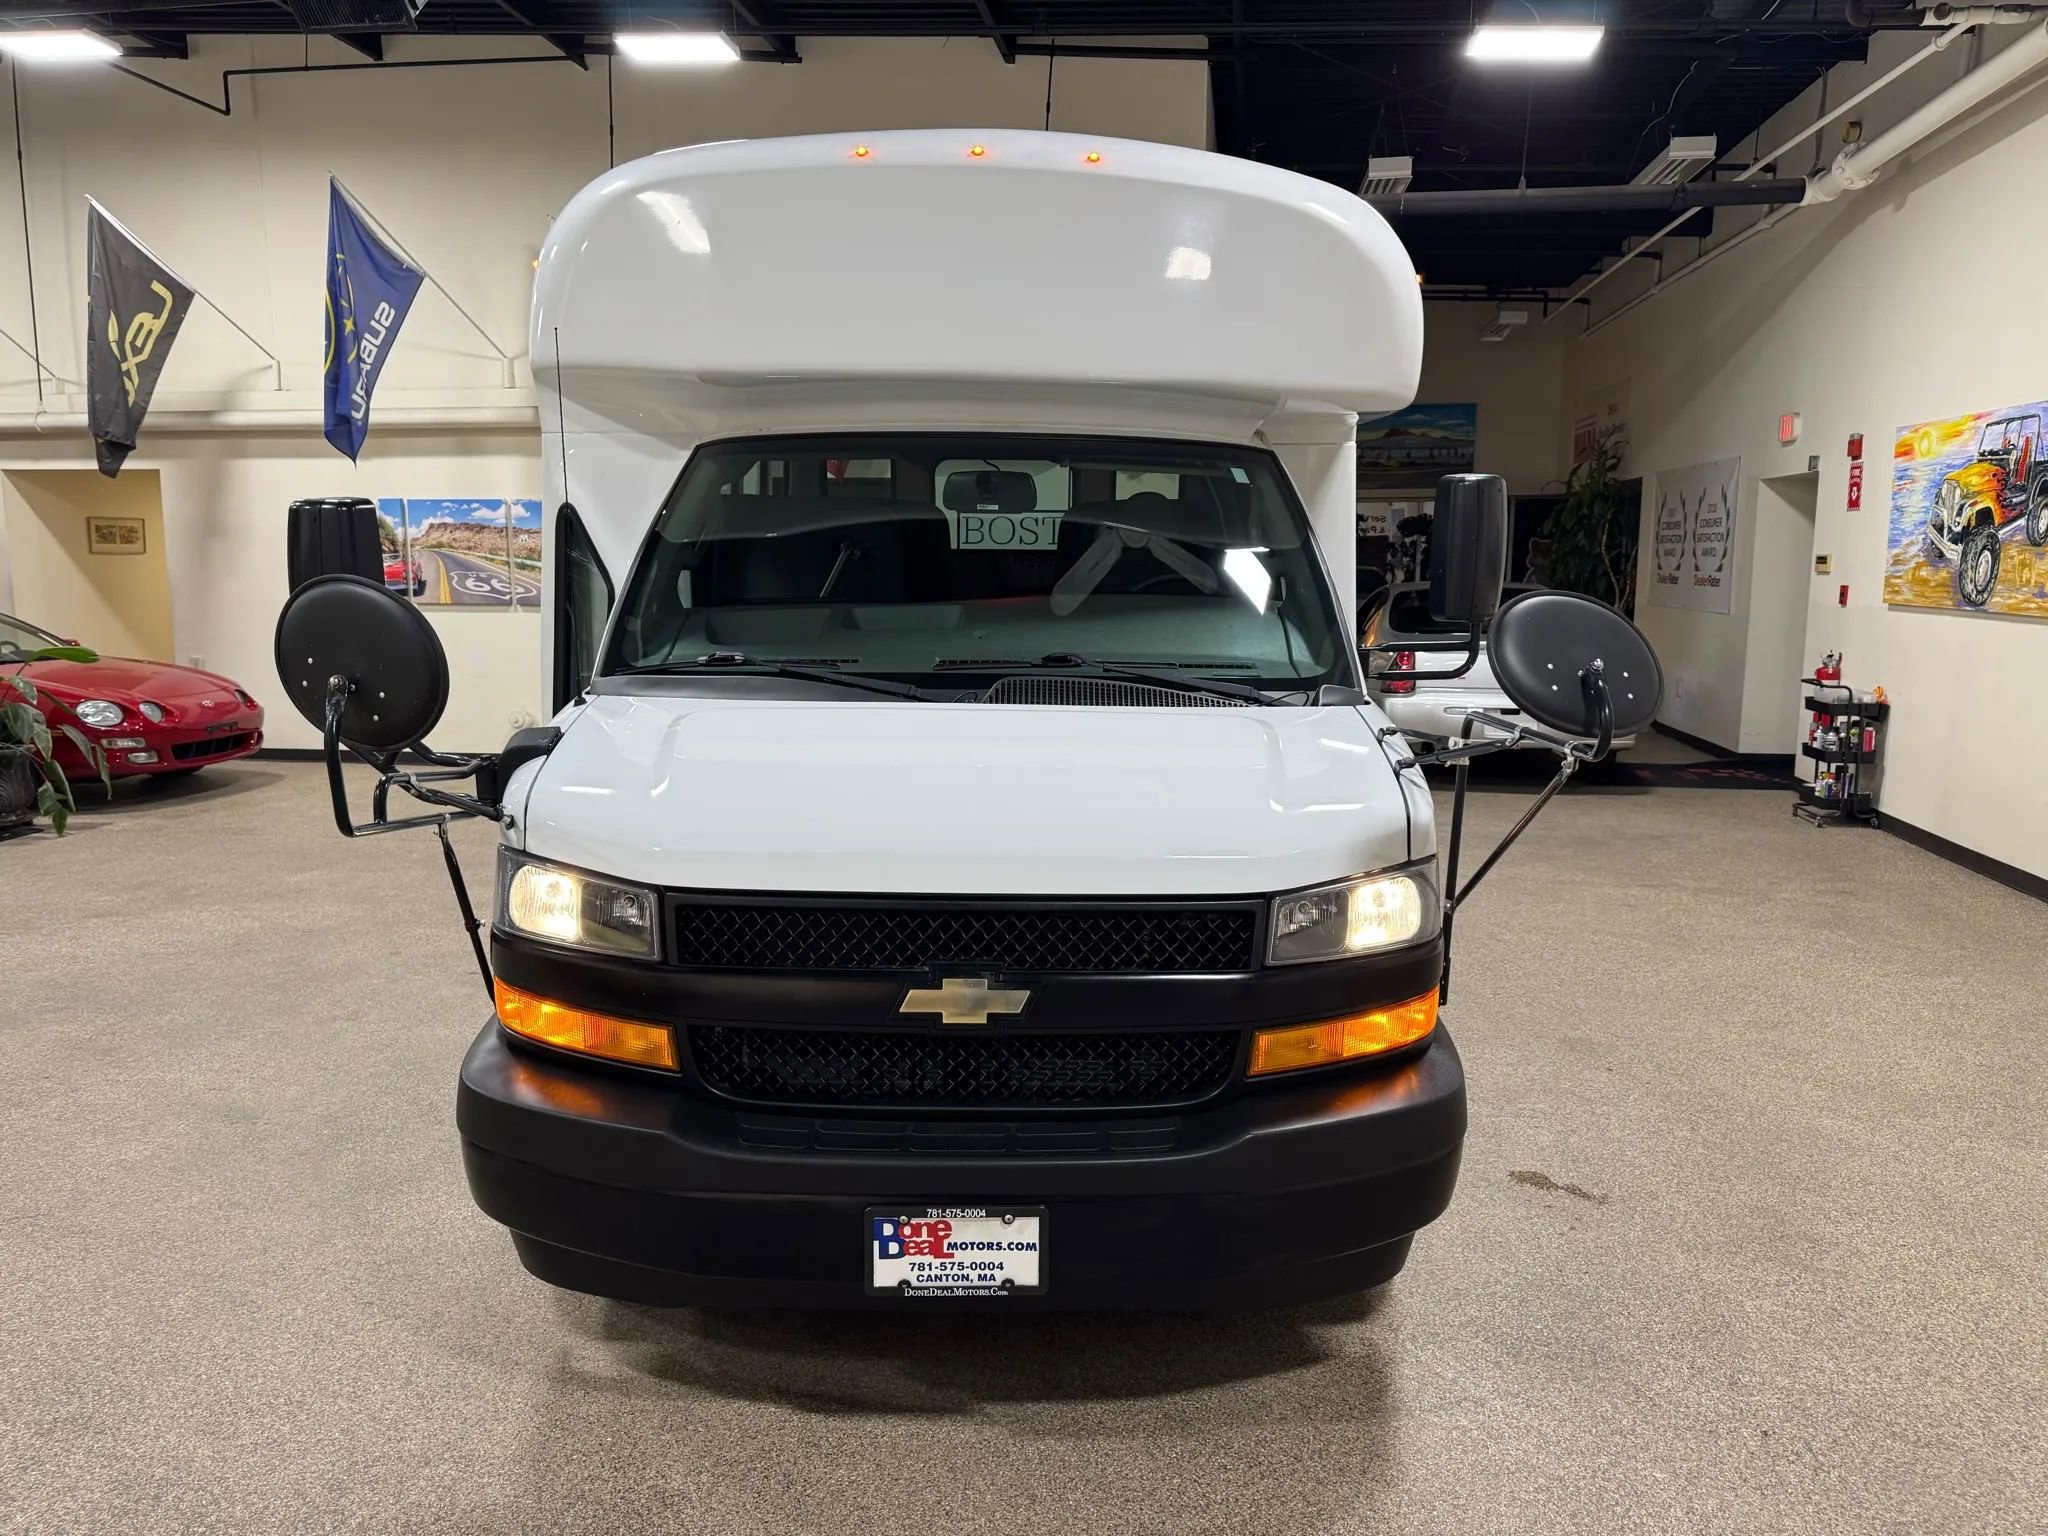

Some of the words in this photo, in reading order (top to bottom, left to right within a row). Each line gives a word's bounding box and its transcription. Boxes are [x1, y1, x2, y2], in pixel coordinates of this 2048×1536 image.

[926, 1208, 986, 1218] 781-575-0004
[946, 1241, 1038, 1252] MOTORS.COM
[909, 1262, 1004, 1272] 781-575-0004
[916, 1273, 973, 1284] CANTON,
[977, 1273, 996, 1282] MA
